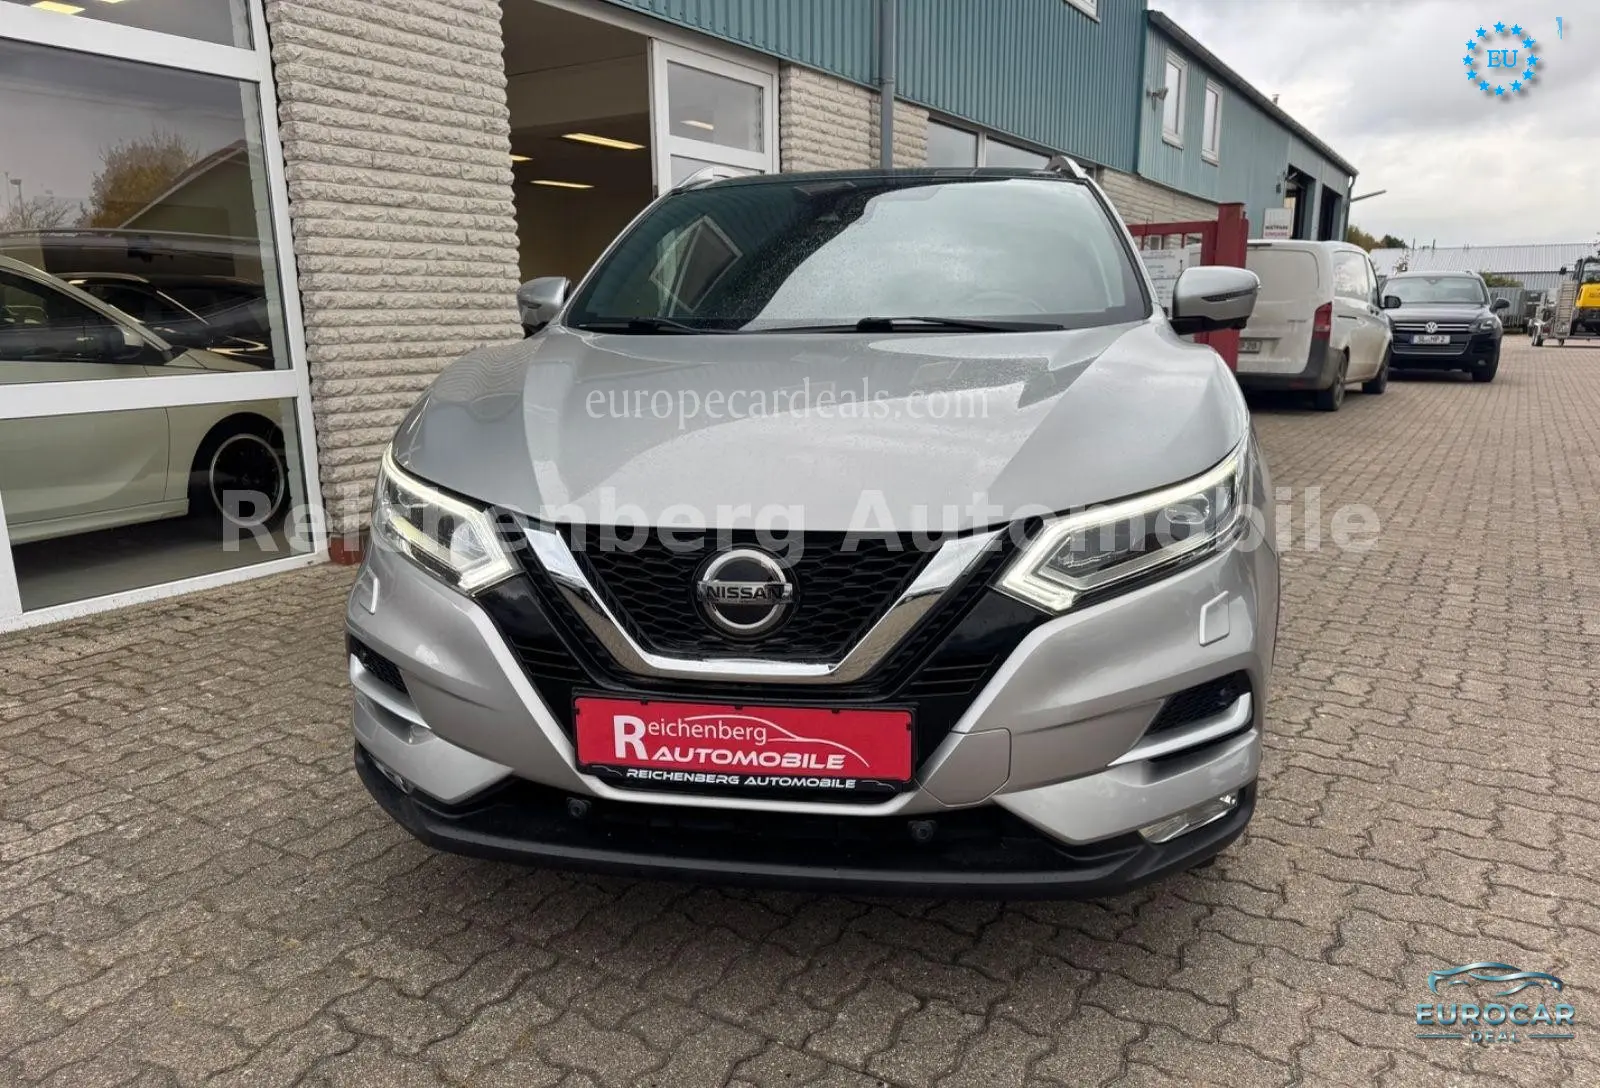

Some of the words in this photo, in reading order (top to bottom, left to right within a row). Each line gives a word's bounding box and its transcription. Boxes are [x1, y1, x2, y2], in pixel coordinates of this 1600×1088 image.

[706, 585, 783, 600] NISSAN
[613, 714, 768, 760] Reichenberg
[651, 745, 847, 771] AUTOMOBILE
[626, 768, 740, 785] REICHENBERG
[744, 776, 857, 789] AUTOMOBILE
